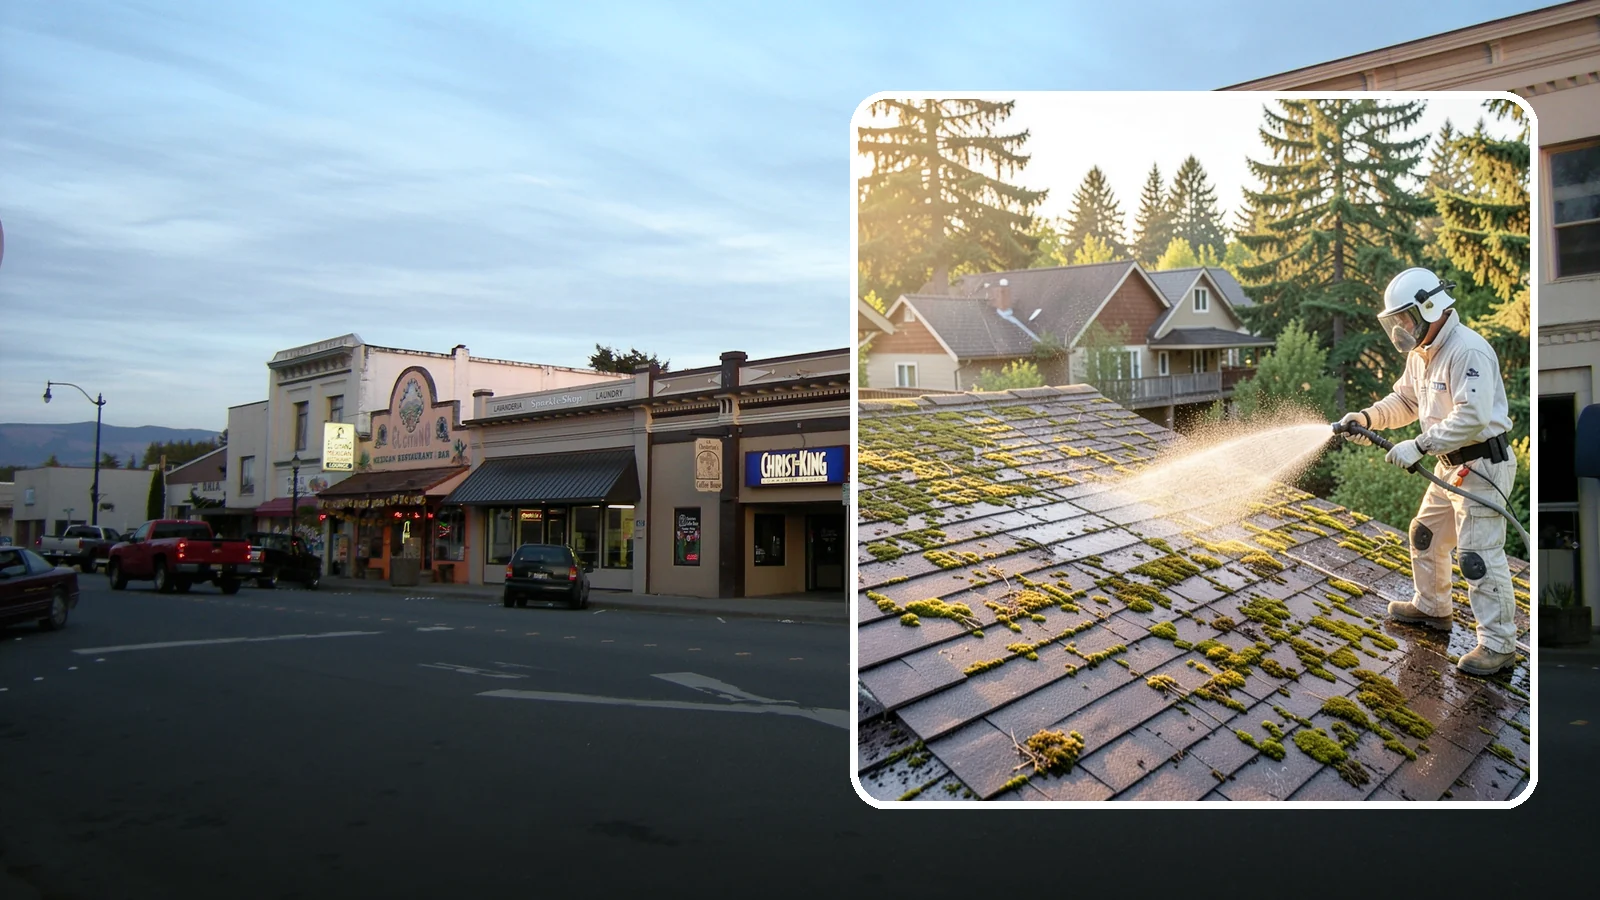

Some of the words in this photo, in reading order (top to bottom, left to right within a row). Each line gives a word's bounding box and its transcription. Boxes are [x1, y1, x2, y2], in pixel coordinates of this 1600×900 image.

[494, 402, 522, 412] LAVANDERIA
[596, 389, 623, 399] LAUNDRY
[374, 455, 396, 464] MEXICAN
[397, 452, 433, 462] RESTAURANT
[438, 450, 450, 459] BAR
[761, 452, 797, 478] CHRIST
[799, 450, 827, 476] KING
